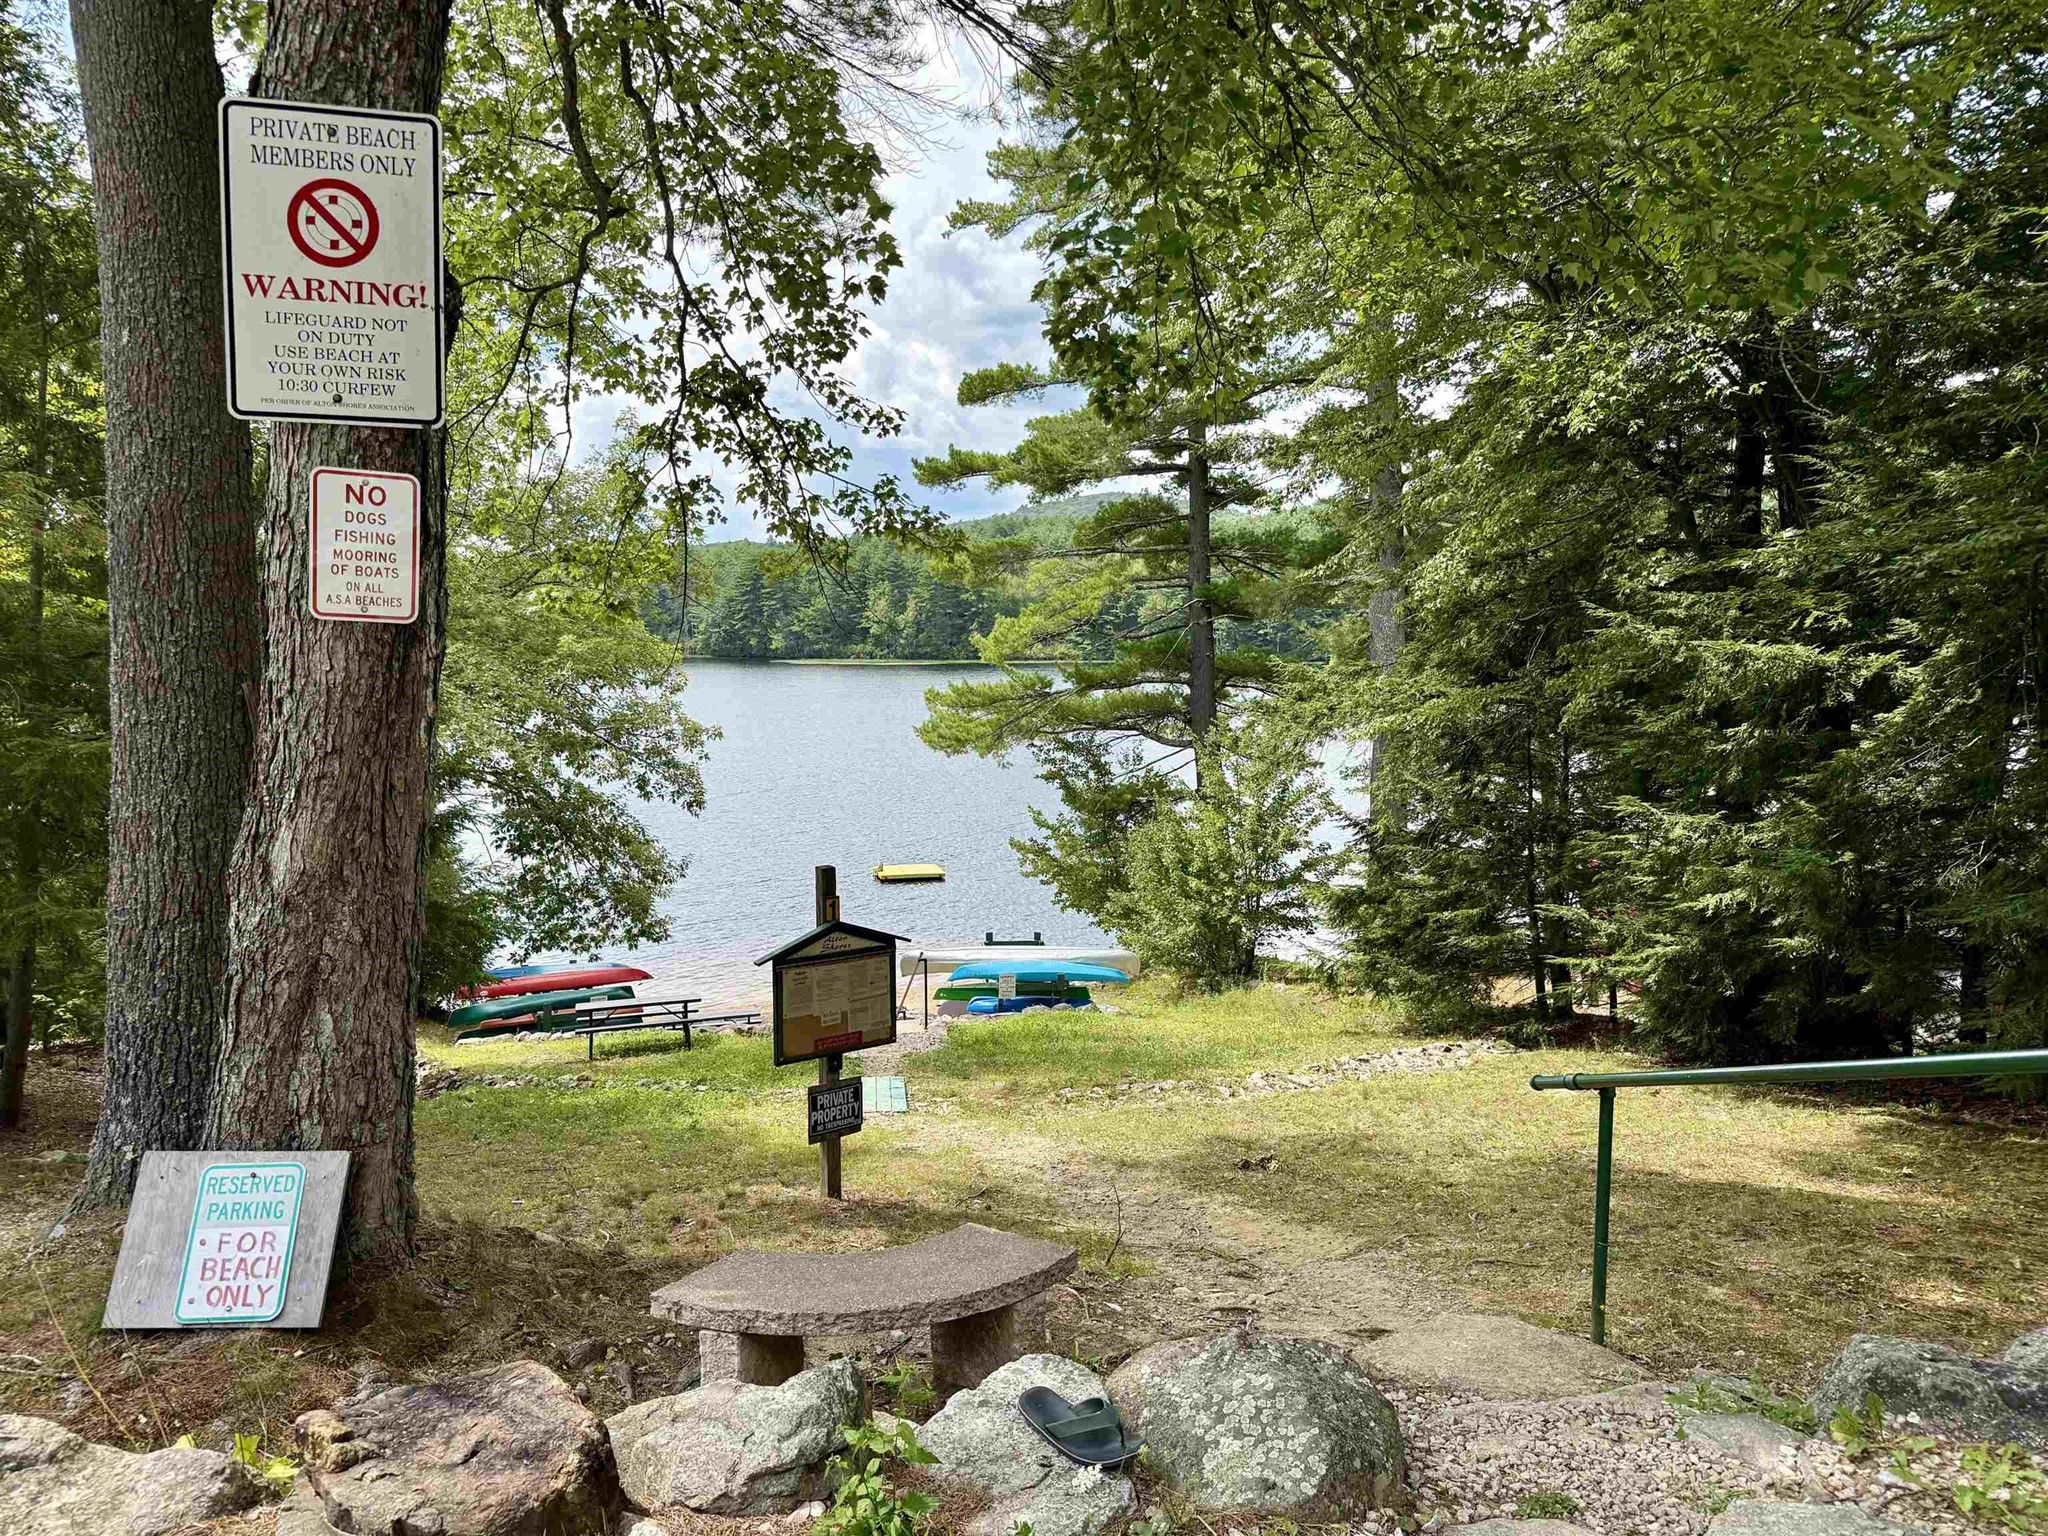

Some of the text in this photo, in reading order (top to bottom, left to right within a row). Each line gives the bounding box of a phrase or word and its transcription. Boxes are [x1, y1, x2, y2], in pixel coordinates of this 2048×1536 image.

[249, 116, 416, 150] PRIVATE BEACH
[250, 144, 416, 177] MEMBERS ONLY
[241, 273, 428, 309] WARNING!
[264, 311, 408, 332] LIFEGUARD NOT
[297, 330, 375, 347] ON DUTY
[274, 345, 400, 364] USE BEACH AT
[267, 361, 407, 381] YOUR OWN RISK
[278, 379, 396, 397] 10:30 CURFEW
[276, 398, 301, 406] ORDER
[313, 400, 336, 408] ALTON
[338, 402, 367, 410] SHORES
[368, 404, 415, 412] ASSOCIATION
[345, 483, 387, 507] NO
[345, 510, 387, 526] DOGS
[334, 529, 396, 546] FISHING
[333, 548, 397, 564] MOORING
[330, 563, 400, 579] OF BOATS
[346, 581, 385, 594] ON ALL
[355, 595, 403, 608] BEACHES
[816, 1088, 854, 1110] PRIVATE
[811, 1101, 860, 1126] PROPERTY
[816, 1123, 824, 1131] NO
[206, 1174, 296, 1195] RESERVED
[206, 1200, 285, 1221] PARKING
[217, 1231, 277, 1253] FOR
[200, 1255, 282, 1282] BEACH
[206, 1284, 274, 1308] ONLY
